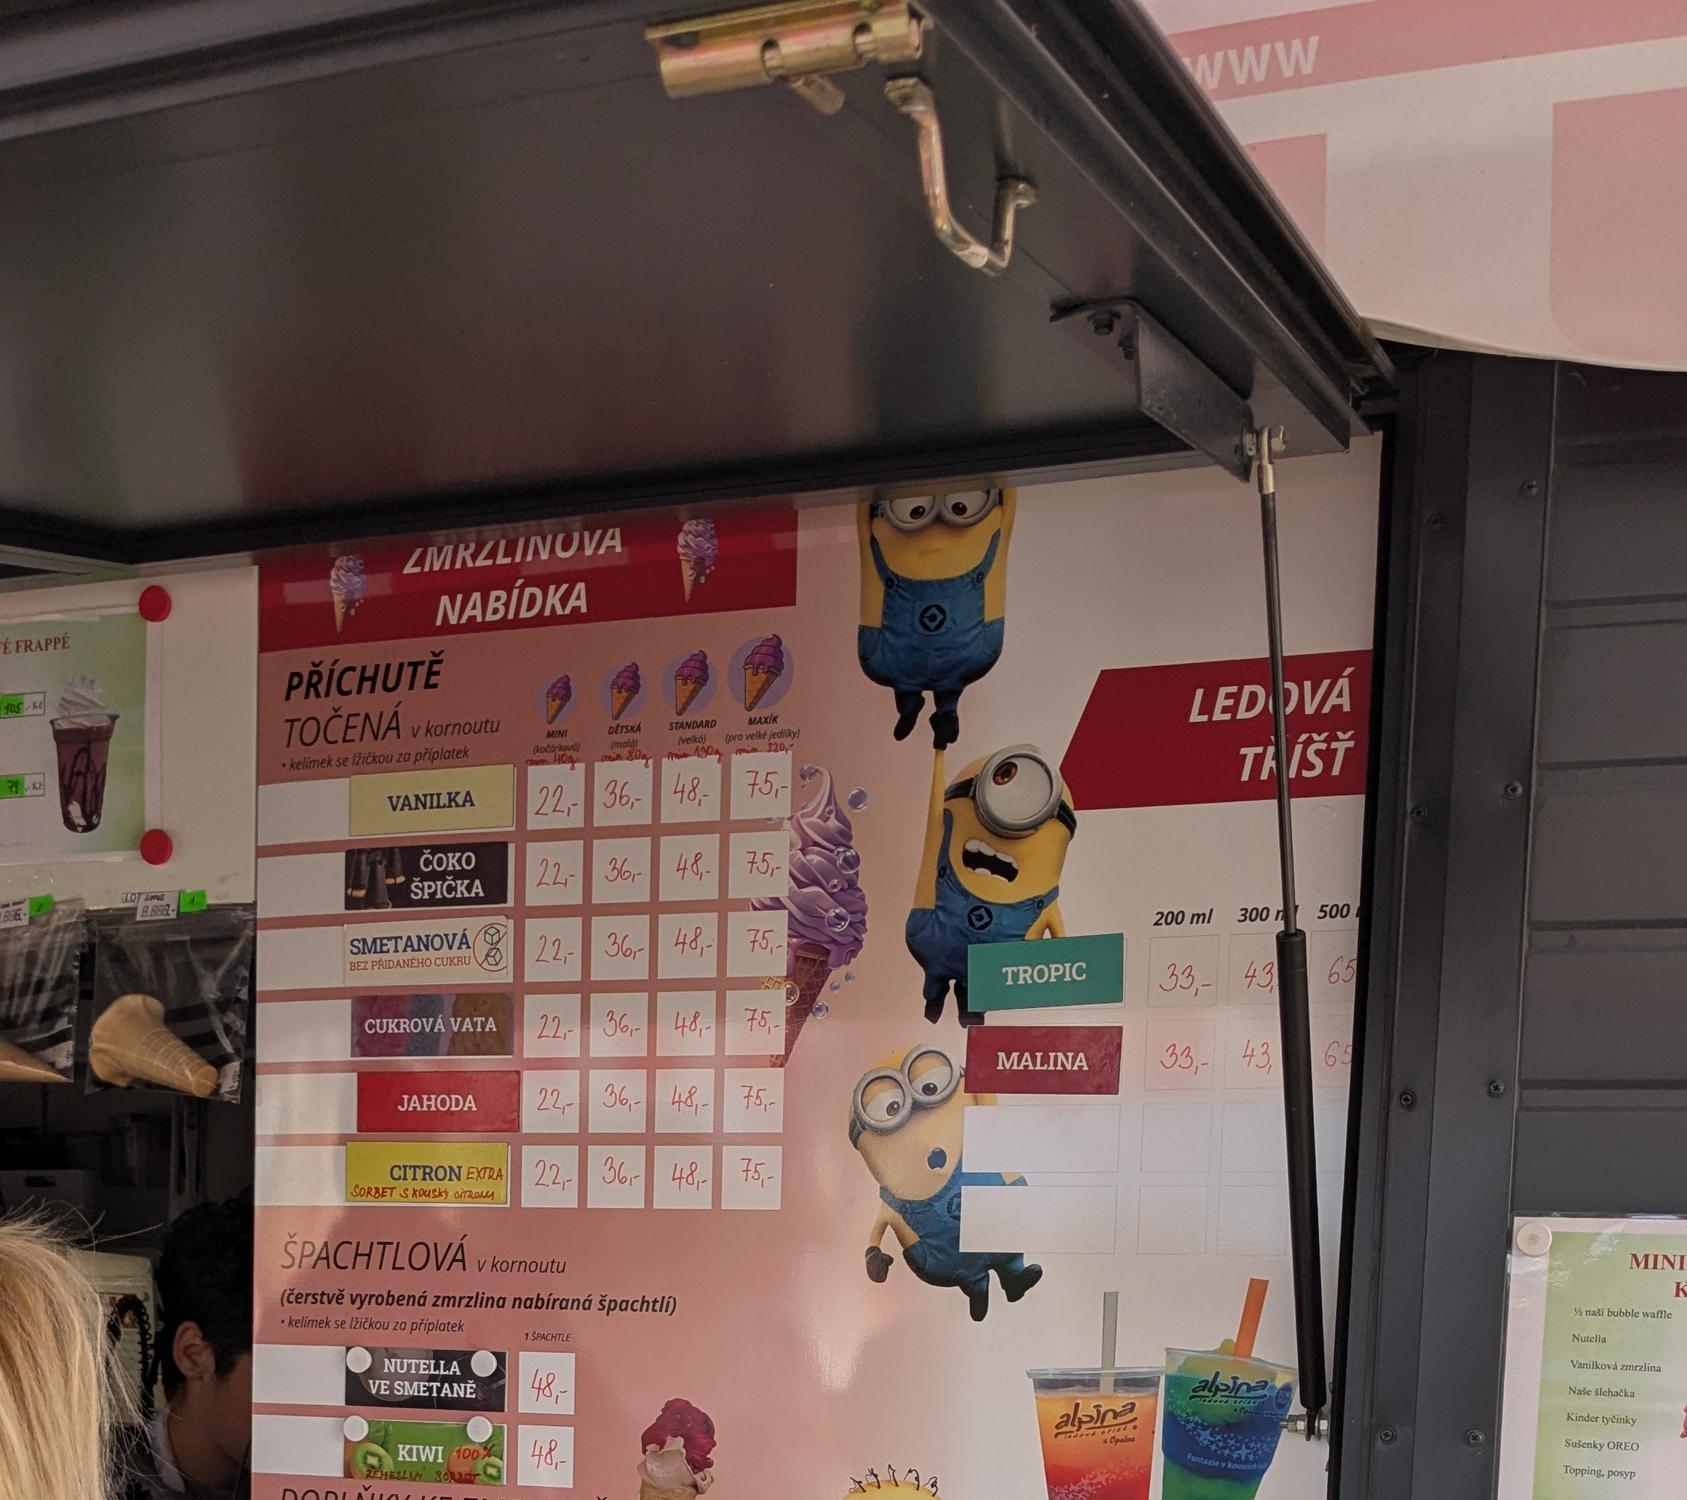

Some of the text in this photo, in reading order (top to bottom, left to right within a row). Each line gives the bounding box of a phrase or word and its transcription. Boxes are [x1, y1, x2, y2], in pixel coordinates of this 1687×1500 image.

[435, 578, 588, 627] NABÍDKA
[15, 632, 71, 653] FRAPPÉ
[284, 649, 445, 702] PŘÍCHUTĚ
[1188, 666, 1356, 723] LEDOVÁ
[284, 701, 500, 748] TOČENÁ v kornoutu
[608, 721, 641, 735] DĚTSKÁ
[668, 719, 716, 732] STANDARD
[748, 714, 779, 727] MAXÍK
[546, 728, 568, 739] MINI
[288, 745, 470, 770] kelímek se lžičkou příplatek
[387, 790, 475, 812] VANILKA
[535, 769, 788, 817] 22,- 36,- 48,- 75,-
[420, 849, 476, 872] ČOKO
[536, 850, 781, 888] 22,- 36,- 48,- 75,-
[410, 876, 485, 900] ŠPIČKA
[1153, 908, 1214, 926] 200 ml
[1237, 906, 1270, 923] 300
[1317, 903, 1351, 920] 500
[350, 928, 471, 956] SMETANOVÁ
[535, 926, 783, 965] 22,- 36,- 48,- 75,-
[350, 955, 471, 972] BEZ PŘIDANÉHO CUKRU
[1002, 962, 1087, 985] TROPIC
[1159, 962, 1212, 997] 33,-
[364, 1013, 497, 1034] CUKROVÁ VATA
[537, 1007, 780, 1041] 22,- 36,- 48,- 75,-
[996, 1051, 1089, 1071] MALINA
[1160, 1043, 1209, 1075] 33,-
[397, 1094, 477, 1112] JAHODA
[537, 1083, 776, 1115] 22,- 36,- 48,- 75,-
[389, 1164, 504, 1182] CITRON EXTRA
[535, 1156, 774, 1192] 22,- 36,- 48,- 75,-
[281, 1232, 567, 1275] ŠPACHTLOVÁ v kornoutu
[1629, 1253, 1687, 1272] MINI
[280, 1288, 677, 1317] (čerstvě vyrobená zmrzlina nabíraná špachtlí)
[1607, 1307, 1673, 1320] bubble waffle
[287, 1315, 464, 1336] kelímek se lžičkou příplatek
[530, 1330, 571, 1343] ŠPACHTLE
[1572, 1333, 1607, 1344] Nutella
[383, 1358, 461, 1376] NUTELLA
[1571, 1359, 1662, 1373] Vanilková zmrzlina
[368, 1379, 476, 1399] VE SMETANĚ
[531, 1369, 568, 1404] 48,-
[1192, 1370, 1269, 1397] alpina
[1568, 1386, 1636, 1398] Naše šlehačka
[1055, 1402, 1136, 1431] alpina
[1567, 1412, 1637, 1427] Kinder tyčinky
[397, 1444, 444, 1463] KIWI
[531, 1439, 567, 1470] 48,-
[1565, 1438, 1640, 1452] Sušenky OREO
[1607, 1470, 1637, 1480] posyp
